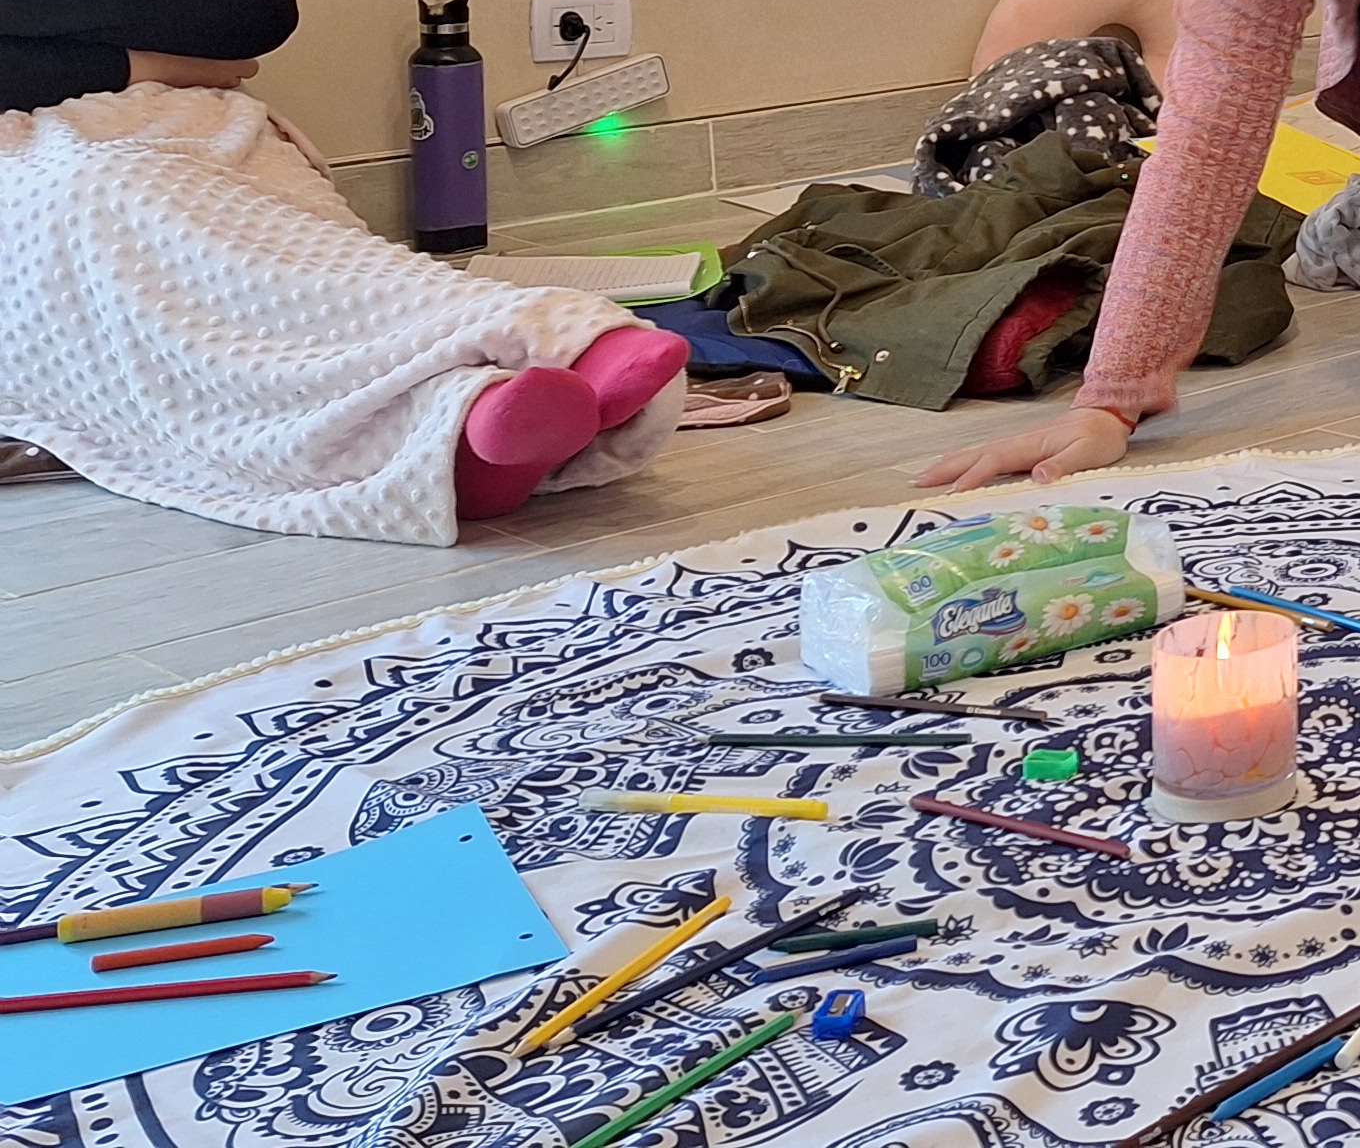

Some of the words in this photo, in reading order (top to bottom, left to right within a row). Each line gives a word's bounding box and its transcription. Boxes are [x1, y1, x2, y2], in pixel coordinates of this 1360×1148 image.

[902, 575, 932, 596] 100
[937, 592, 1015, 641] Elegante
[922, 652, 952, 669] 100
